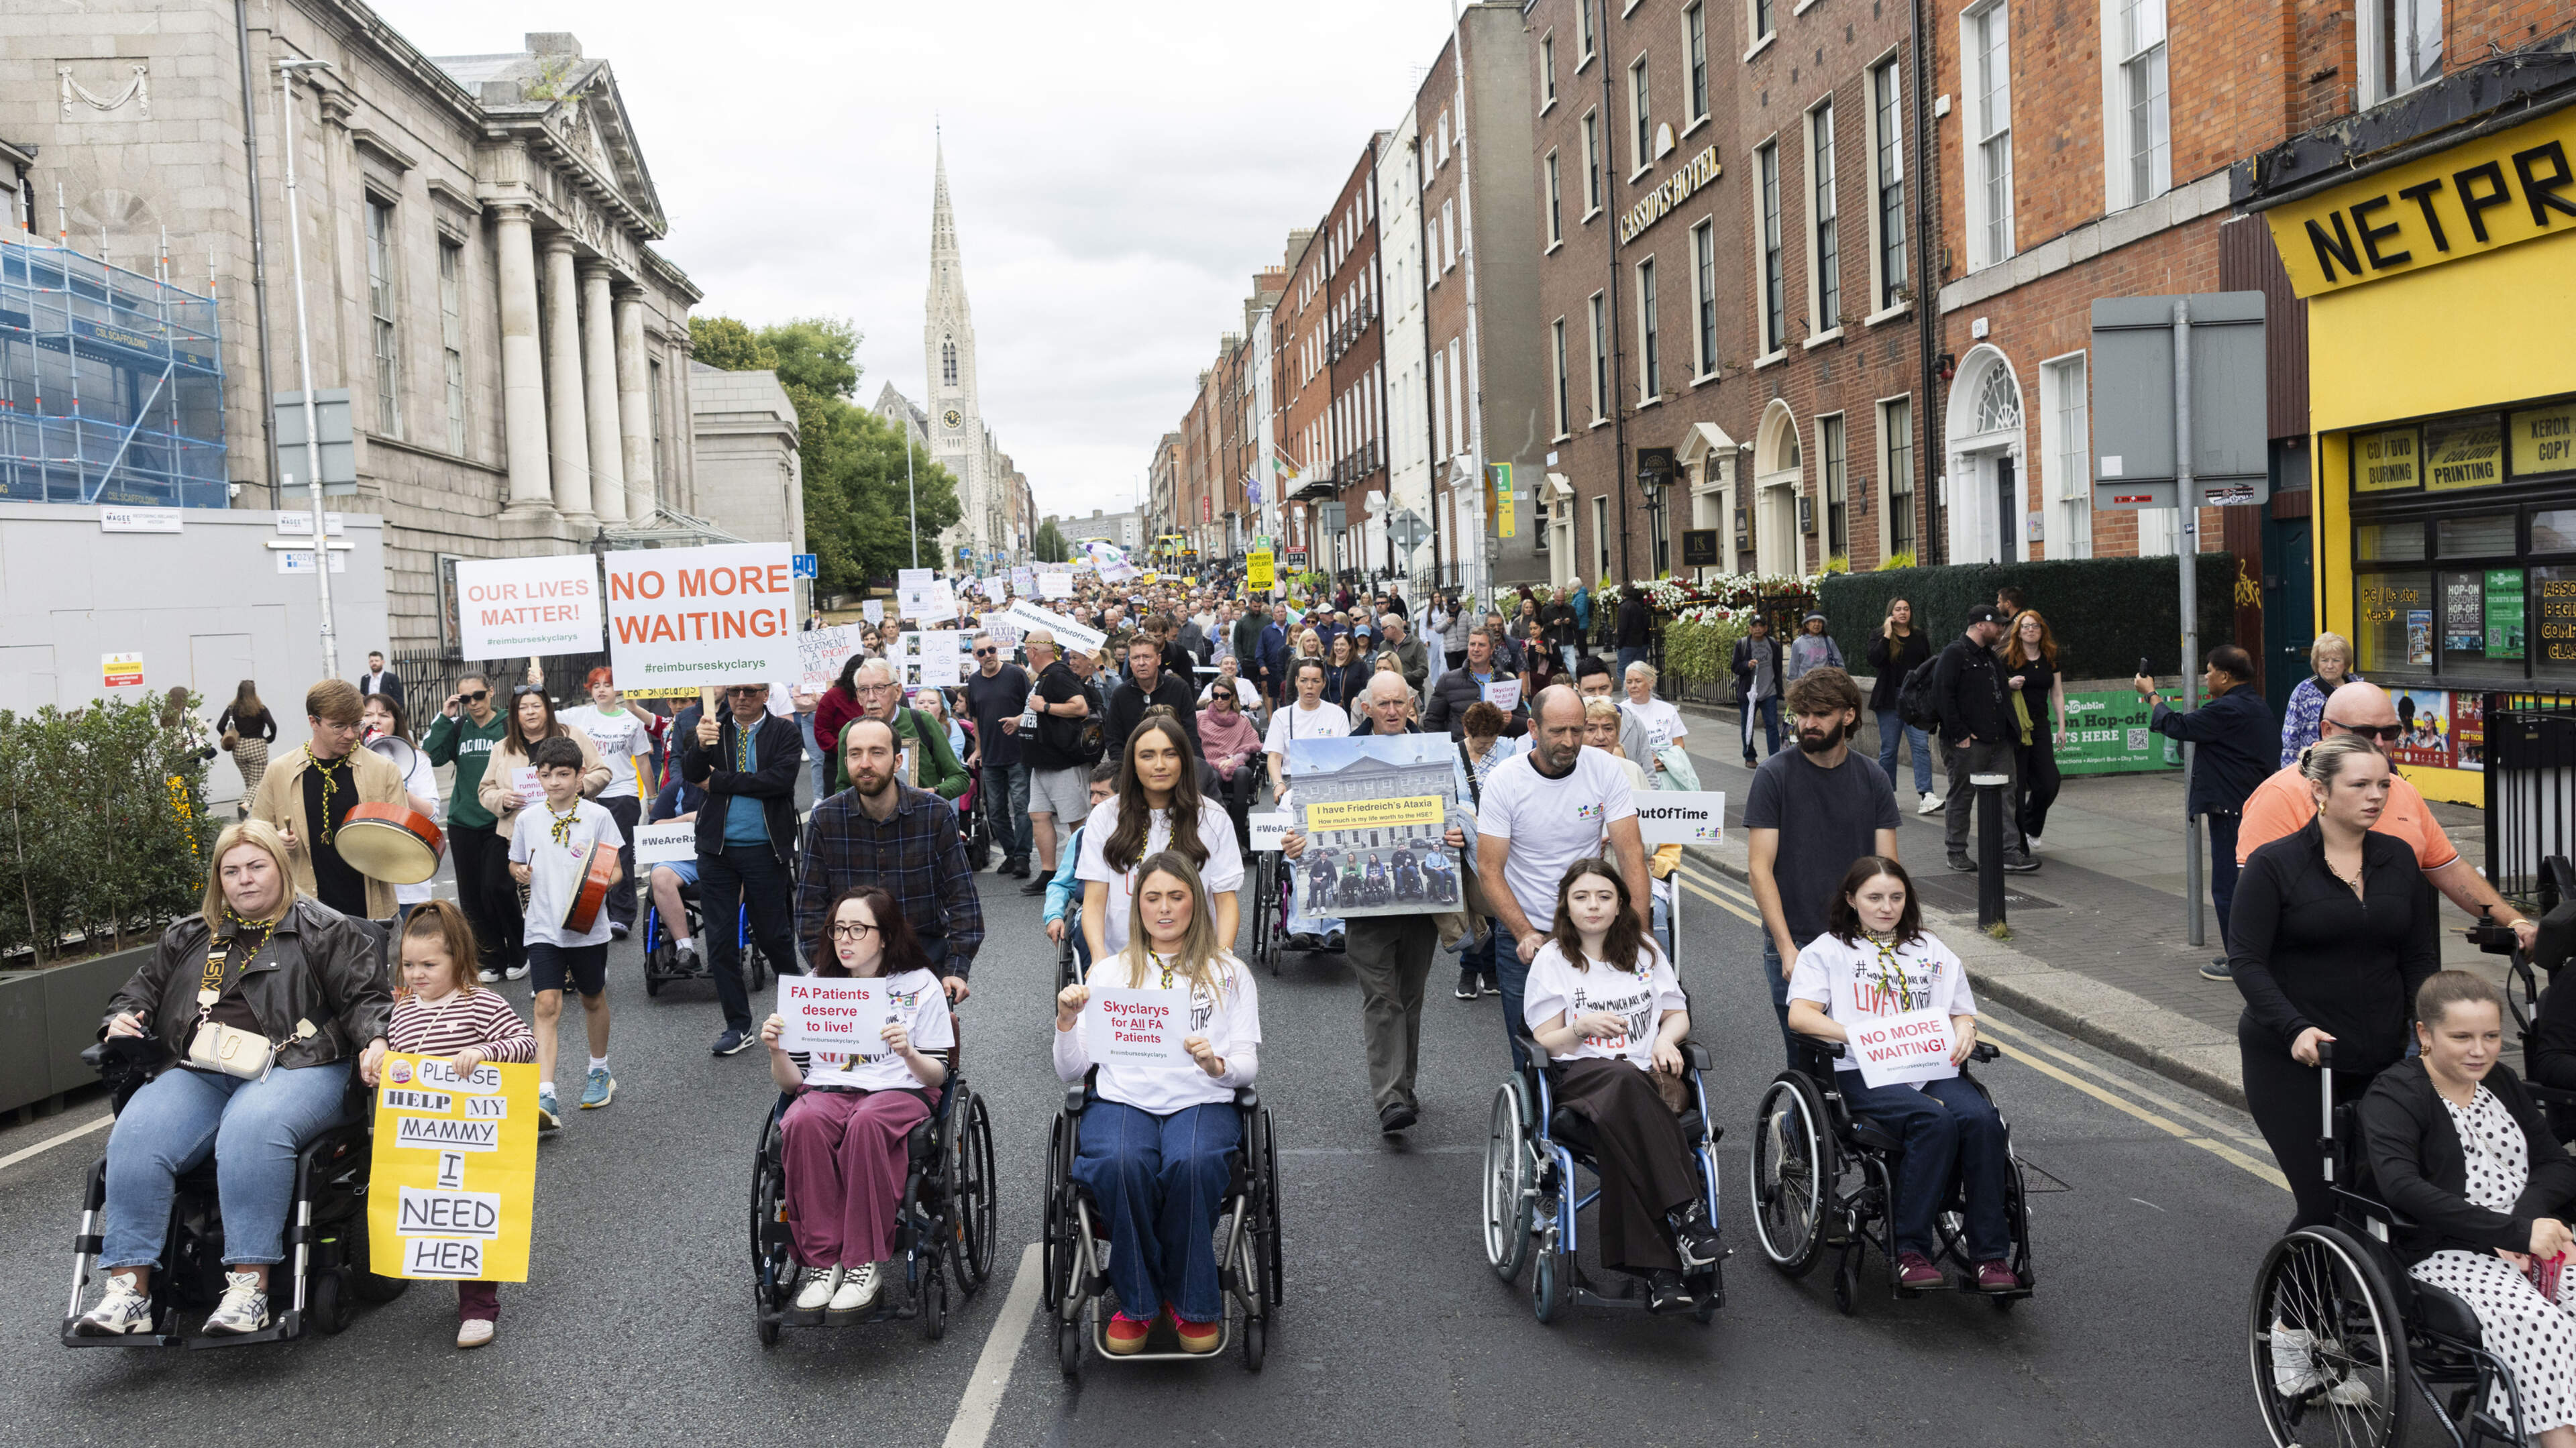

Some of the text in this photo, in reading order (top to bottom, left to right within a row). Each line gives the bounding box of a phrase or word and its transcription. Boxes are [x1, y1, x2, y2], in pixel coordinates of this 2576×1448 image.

[1621, 144, 1723, 245] CASSIDYS HOTEL
[2304, 140, 2576, 282] NETPR
[96, 328, 148, 349] CSL SCAFFOLDING
[188, 354, 199, 364] CSL
[2531, 416, 2570, 439] XEROX
[2367, 442, 2381, 459] CD
[2391, 438, 2411, 457] DVD
[2443, 445, 2500, 463] COLOUR
[2538, 439, 2571, 461] COPY
[2369, 463, 2412, 484] BURNING
[2434, 461, 2494, 484] PRINTING
[120, 493, 159, 506] SCAFFOLDING
[106, 514, 131, 522] MAGEE
[610, 564, 790, 601] NO MORE
[1016, 585, 1032, 594] YES
[2448, 584, 2479, 595] HOP-ON
[468, 579, 589, 602] OUR LIVES
[2363, 588, 2377, 602] PC
[2448, 595, 2479, 604] DISCOVER
[482, 604, 580, 626] MATTER!
[2448, 604, 2479, 614] HOP-OFF
[2448, 613, 2479, 623] EXPLORE
[614, 608, 788, 644] WAITING!
[830, 626, 845, 638] TO
[985, 626, 1016, 636] ATAXIA
[1013, 608, 1095, 645] #WeAreRunningOutOfTime
[487, 633, 578, 646] #reimburseskyclarys
[798, 637, 848, 655] TREATMENT
[812, 645, 851, 661] A RIGHT
[645, 659, 766, 673] #reimburseskyclarys
[804, 658, 838, 671] NOT A
[2065, 700, 2105, 714] oDublin
[2084, 712, 2147, 728] Hop-off
[2081, 730, 2119, 742] HERE
[459, 738, 493, 756] ADIDA
[2086, 757, 2104, 765] Airport
[1323, 805, 1344, 814] have
[1347, 801, 1401, 813] Friedreich's
[1403, 799, 1432, 809] Ataxia
[1709, 827, 1721, 838] afi
[1218, 977, 1233, 989] afi
[791, 987, 870, 1000] FA Patients
[904, 991, 918, 1006] afi
[802, 1004, 857, 1016] deserve
[1104, 1001, 1169, 1017] Skyclarys
[807, 1021, 853, 1033] to live!
[1112, 1017, 1164, 1029] for All FA
[1115, 1032, 1161, 1044] Patients
[1860, 1020, 1943, 1046] NO MORE
[801, 1036, 859, 1046] #reimburseskyclarys
[1110, 1050, 1167, 1058] #reimburseskyclarys
[1867, 1038, 1946, 1062] WAITING!
[423, 1062, 498, 1086] PLESE
[1886, 1061, 1940, 1072] #reimburseskyclarys
[387, 1091, 504, 1115] HELP MY
[402, 1119, 494, 1141] MAMMY
[441, 1154, 462, 1180] I
[402, 1197, 496, 1229] NEED
[415, 1241, 478, 1269] HER
